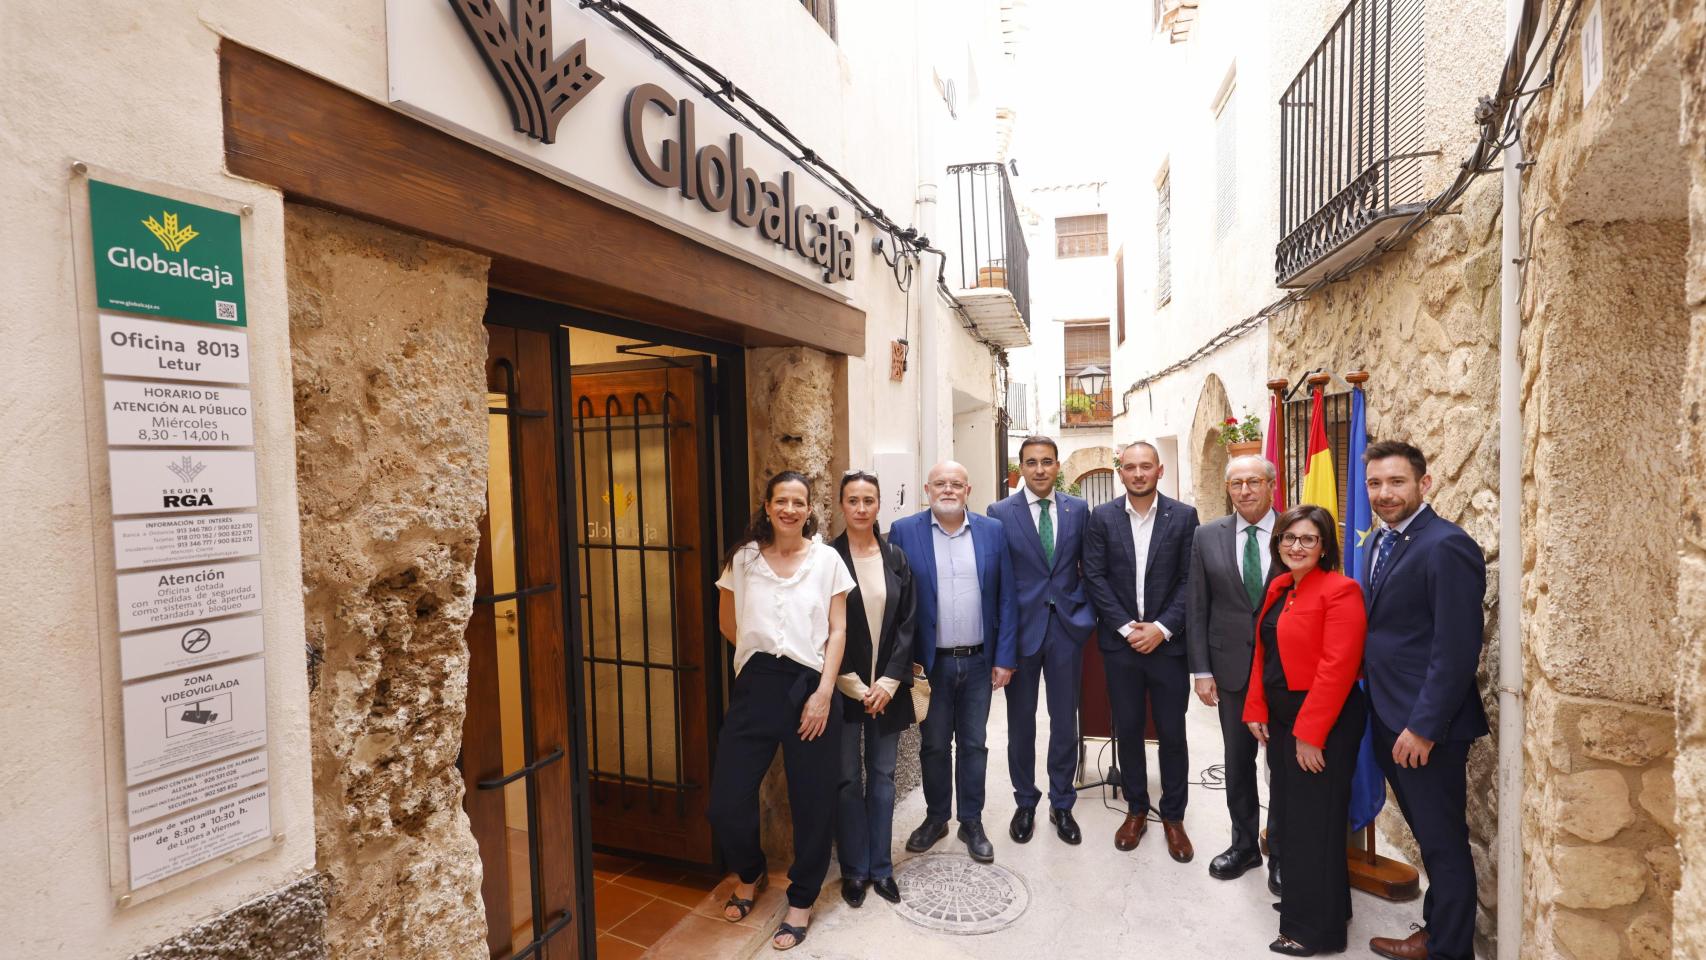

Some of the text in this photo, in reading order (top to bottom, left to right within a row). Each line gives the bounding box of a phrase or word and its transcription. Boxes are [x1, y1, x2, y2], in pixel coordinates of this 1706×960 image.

[623, 82, 855, 283] Globalcaja
[107, 246, 233, 289] Globalcaja
[110, 331, 240, 359] Oficina 8013
[158, 356, 201, 372] Letur
[144, 387, 219, 401] HORARIO DE
[113, 399, 247, 416] ATENCIÓN AL PÚBLICO
[152, 416, 218, 429] Miércoles
[138, 429, 168, 442] 8,30
[181, 430, 218, 442] 14,00
[221, 430, 229, 441] h
[162, 487, 214, 495] SEGUROS
[163, 494, 214, 508] RGA
[145, 519, 194, 529] INFORMACIÓN
[158, 569, 225, 588] Atención
[131, 585, 252, 609] con medidas de seguridad
[157, 582, 224, 597] Oficina dotada
[132, 592, 256, 617] como sistemas de apertura
[150, 601, 242, 622] retardada y bloqueo
[183, 673, 213, 687] ZONA
[161, 678, 240, 703] VIDEOVIGILADA
[132, 791, 266, 843] Horario de ventanilla para servicios
[155, 835, 169, 846] de
[174, 825, 196, 838] 8:30
[211, 811, 235, 825] 10:30
[239, 806, 248, 815] h.
[167, 842, 179, 851] de
[179, 832, 205, 846] Lunes
[211, 819, 241, 834] Viernes
